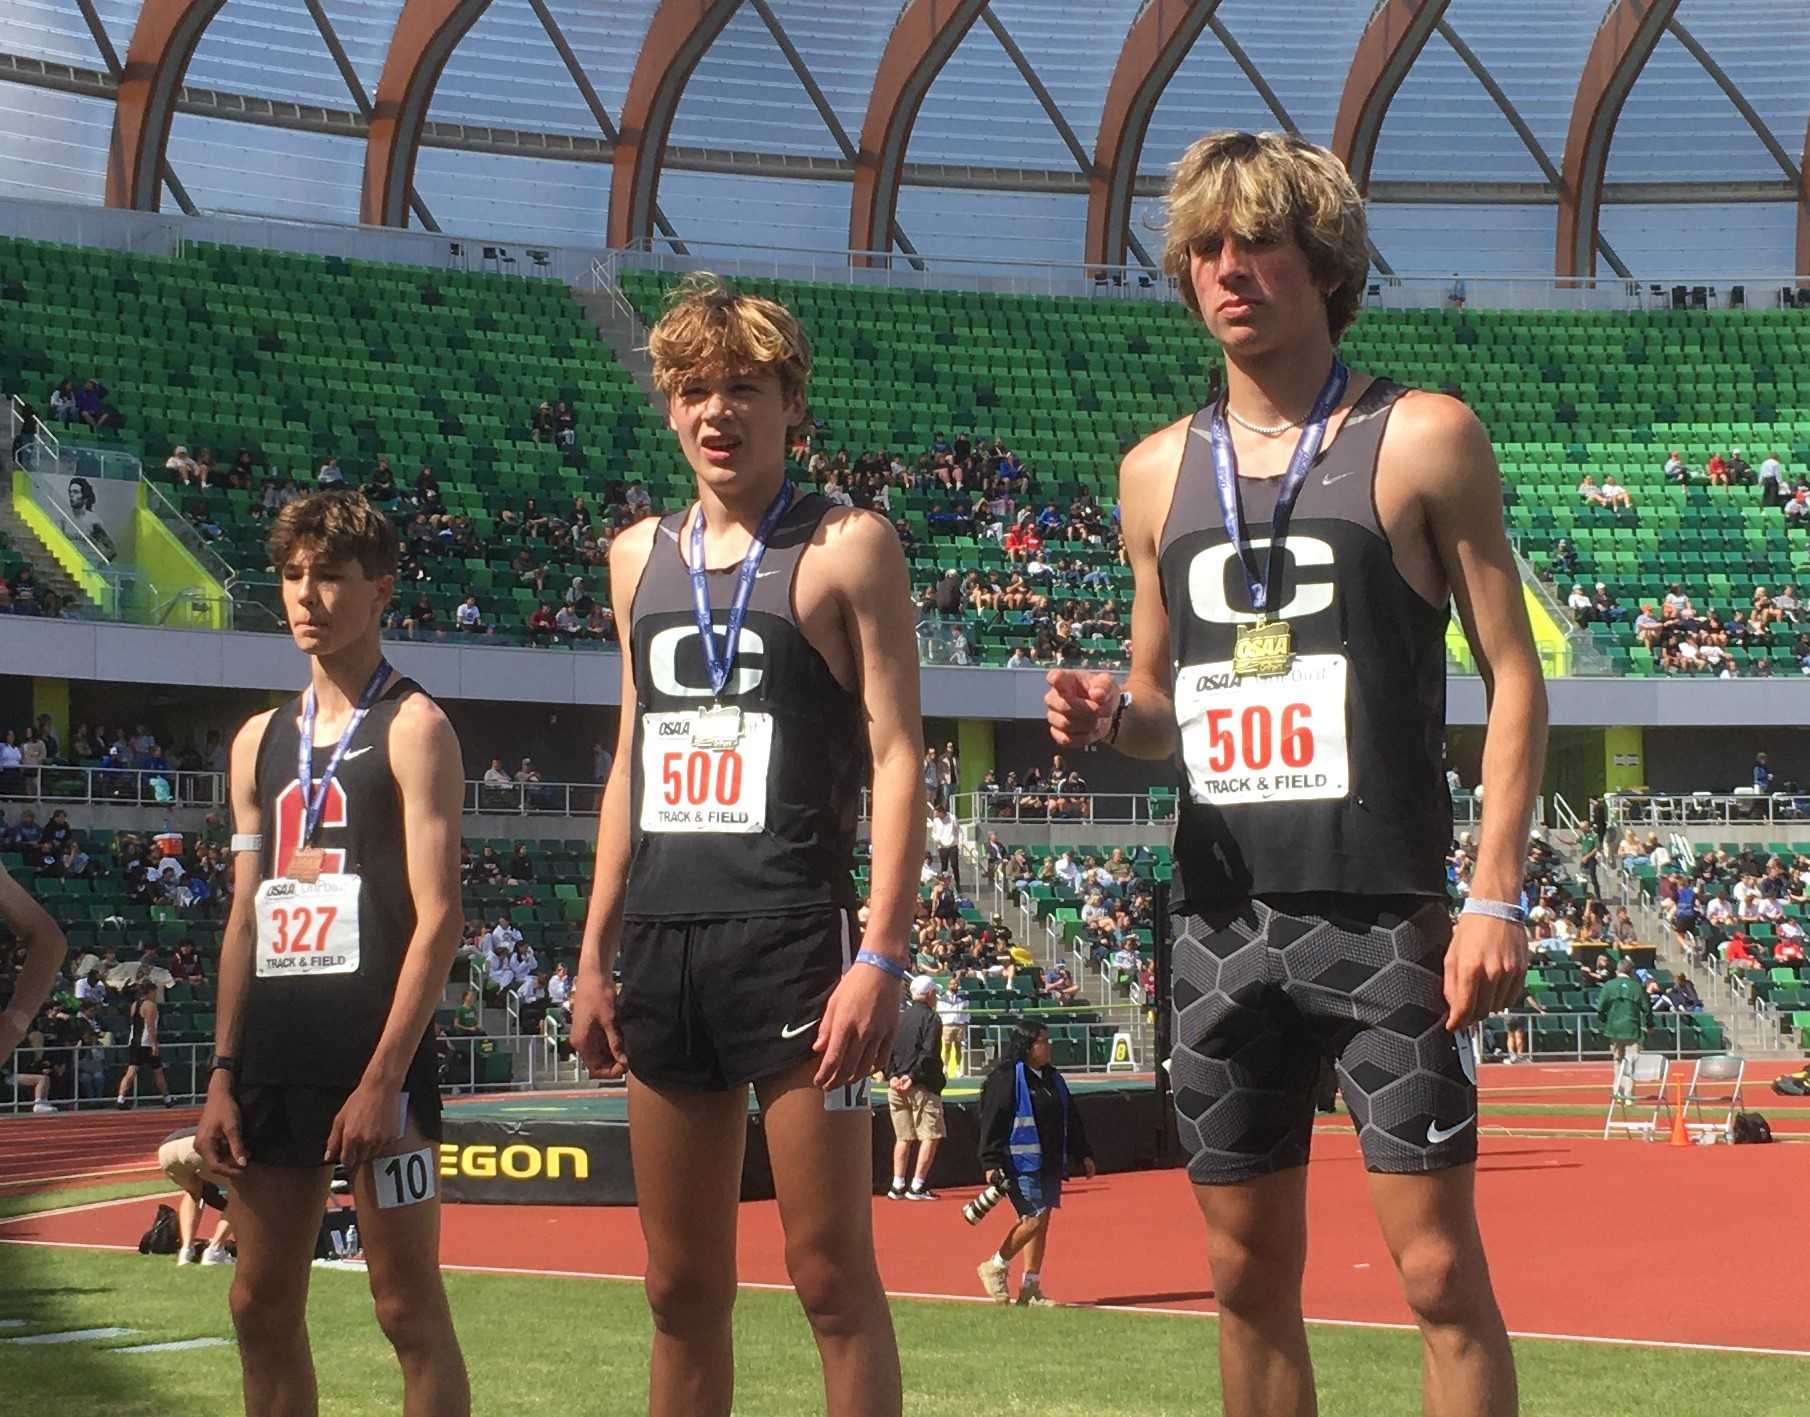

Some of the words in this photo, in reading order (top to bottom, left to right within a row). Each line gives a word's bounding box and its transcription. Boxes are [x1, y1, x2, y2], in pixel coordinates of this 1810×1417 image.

[1188, 536, 1334, 623] C
[650, 624, 764, 697] C
[1236, 636, 1289, 659] OSAA
[1196, 673, 1243, 693] OSAA
[658, 721, 690, 736] OSAA
[1207, 702, 1314, 773] 506
[663, 750, 743, 806] 500
[1204, 777, 1251, 794] TRACK
[1256, 776, 1269, 790] &
[1275, 773, 1327, 790] FIELD
[275, 778, 347, 878] C
[658, 811, 691, 823] TRACK
[694, 811, 704, 823] &
[708, 811, 749, 824] FIELD
[271, 906, 338, 954] 327
[266, 957, 296, 969] TRACK
[299, 956, 308, 968] &
[311, 955, 346, 967] FIELD
[384, 1154, 428, 1204] 10
[440, 1144, 589, 1178] EGON
